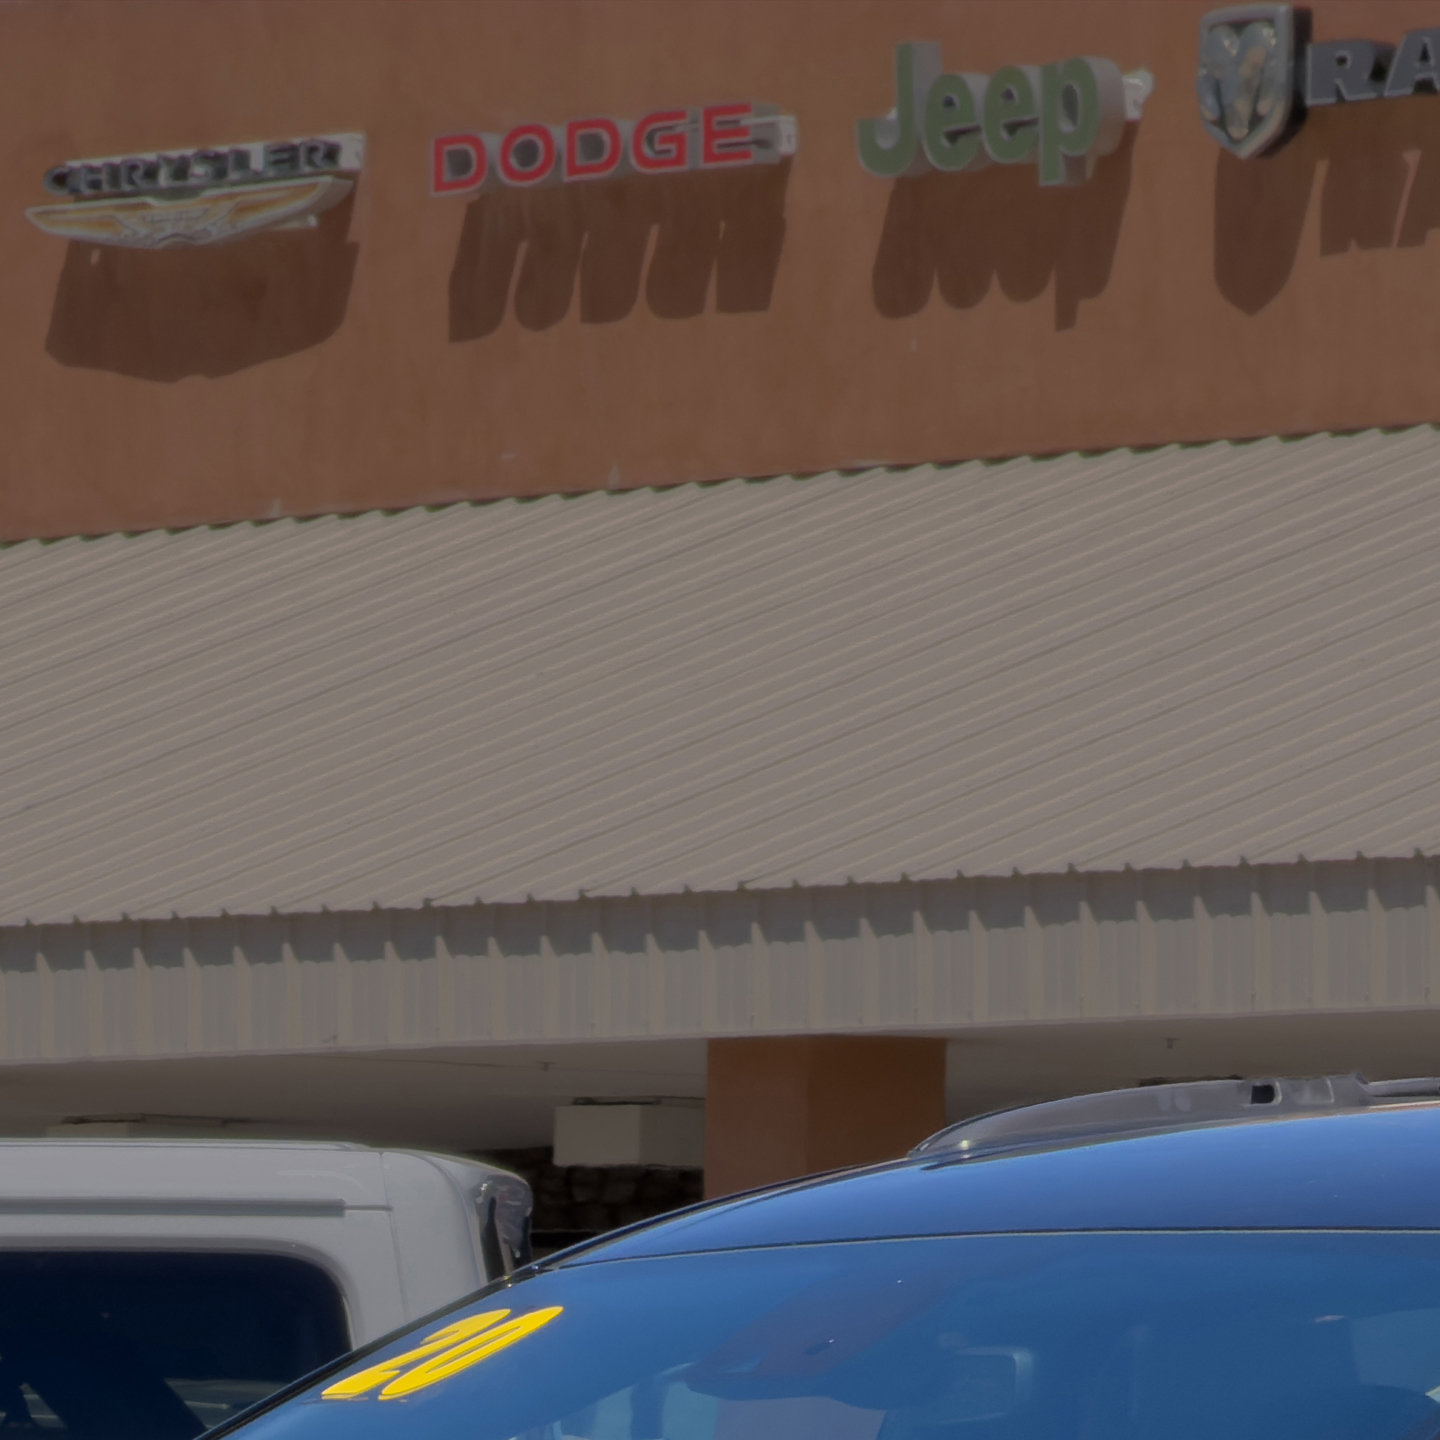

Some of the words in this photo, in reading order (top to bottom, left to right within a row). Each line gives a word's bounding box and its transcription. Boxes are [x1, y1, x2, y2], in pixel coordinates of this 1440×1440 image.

[431, 102, 760, 197] DODGE
[857, 40, 1105, 187] Jeep
[44, 139, 344, 196] CHRYSLER
[321, 1306, 564, 1400] 20
